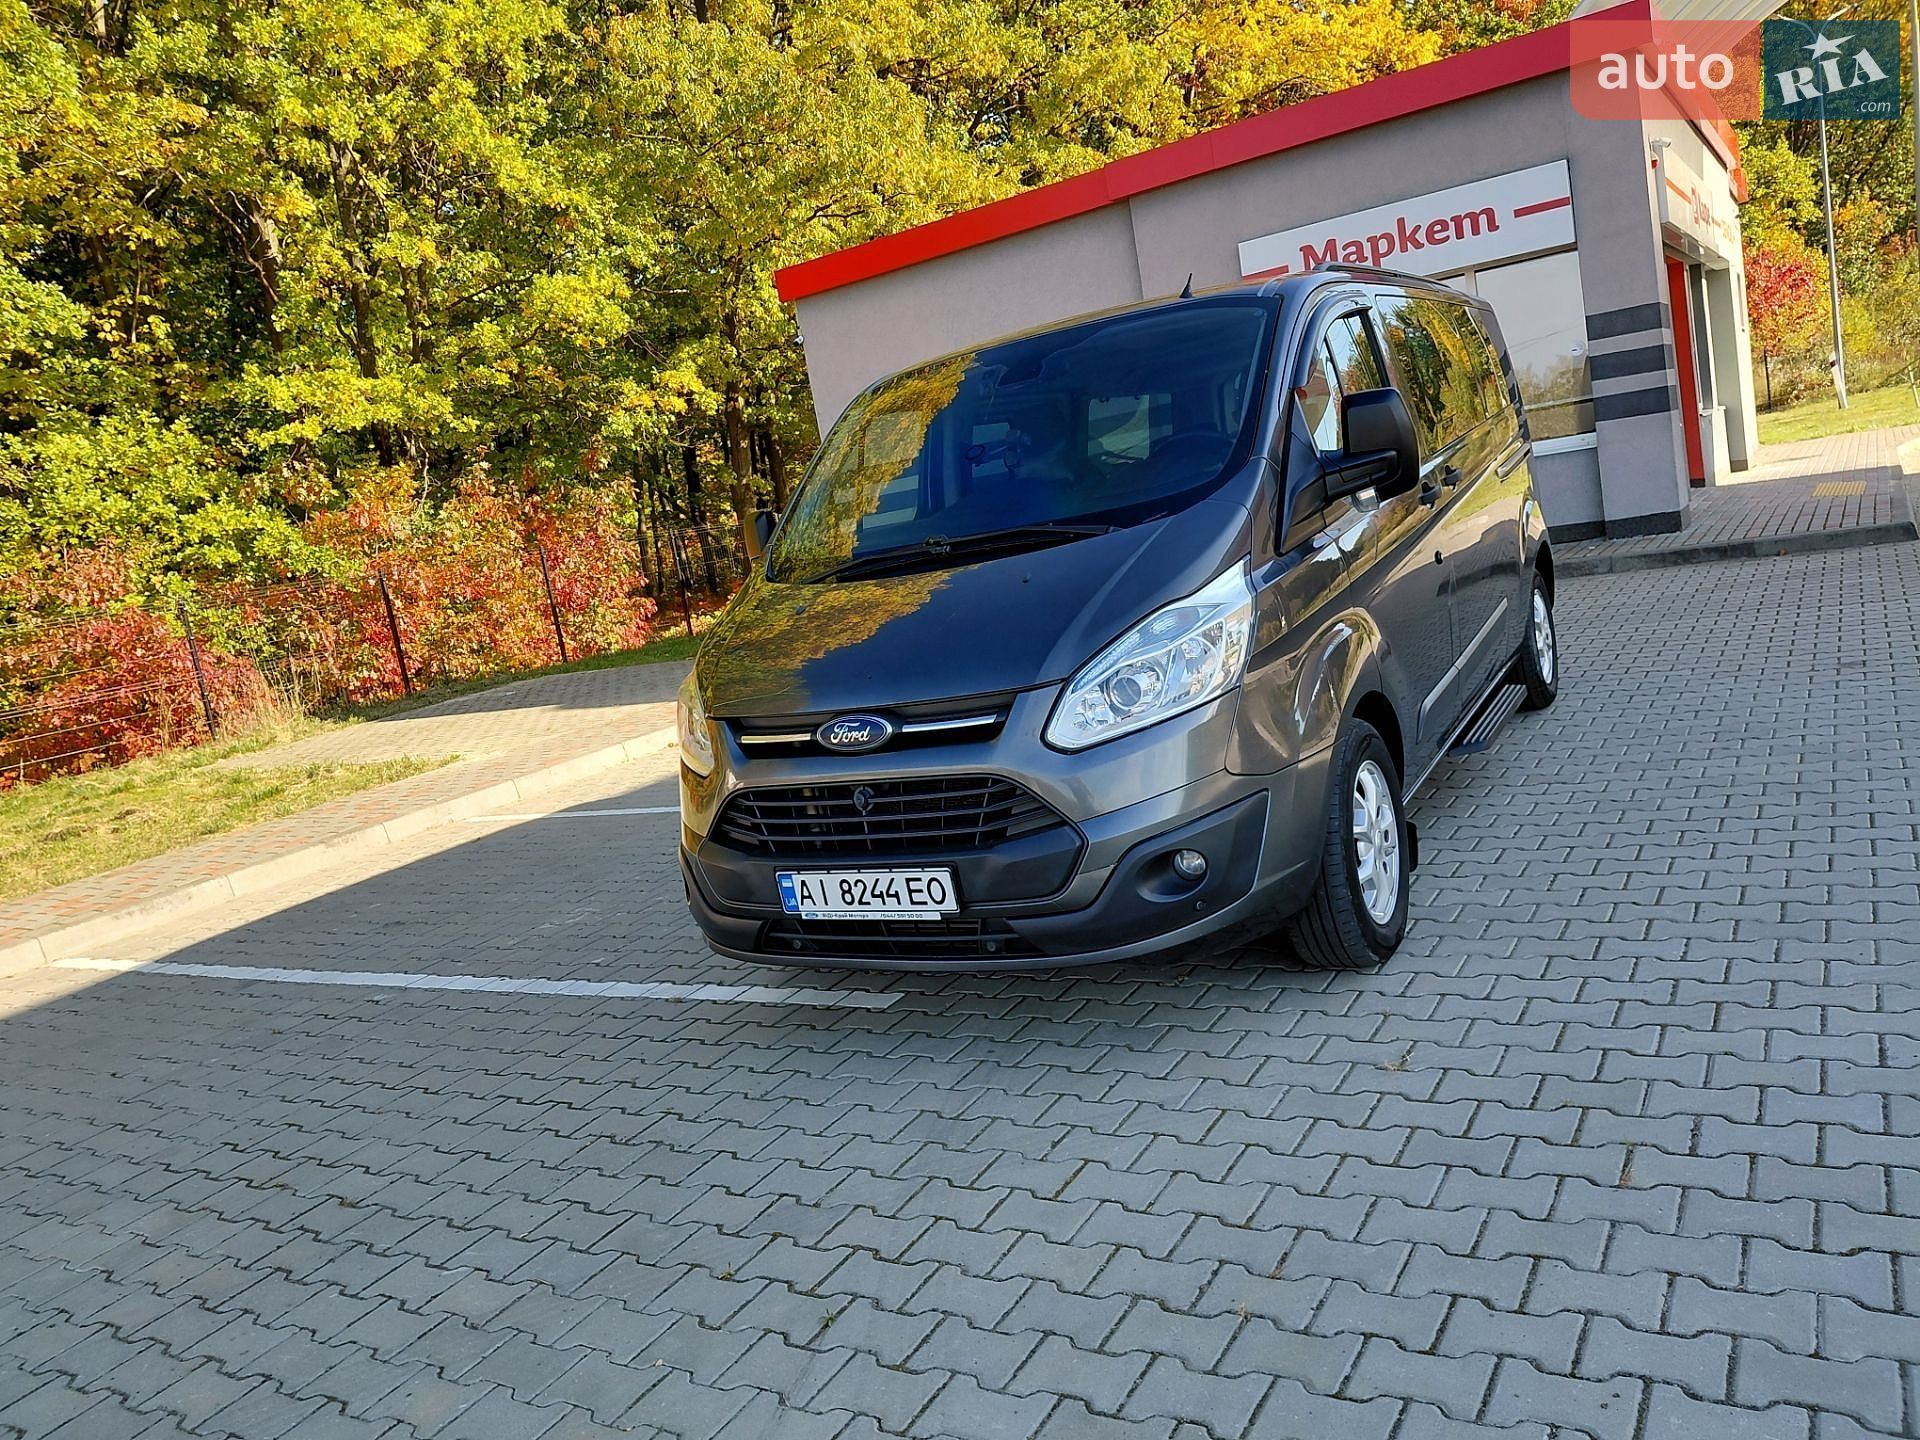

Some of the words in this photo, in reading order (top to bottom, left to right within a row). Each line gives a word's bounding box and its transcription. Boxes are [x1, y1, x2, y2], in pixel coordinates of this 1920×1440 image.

[830, 722, 872, 744] Ford
[800, 878, 829, 906] AI
[839, 877, 902, 906] 8244
[905, 877, 948, 906] EO
